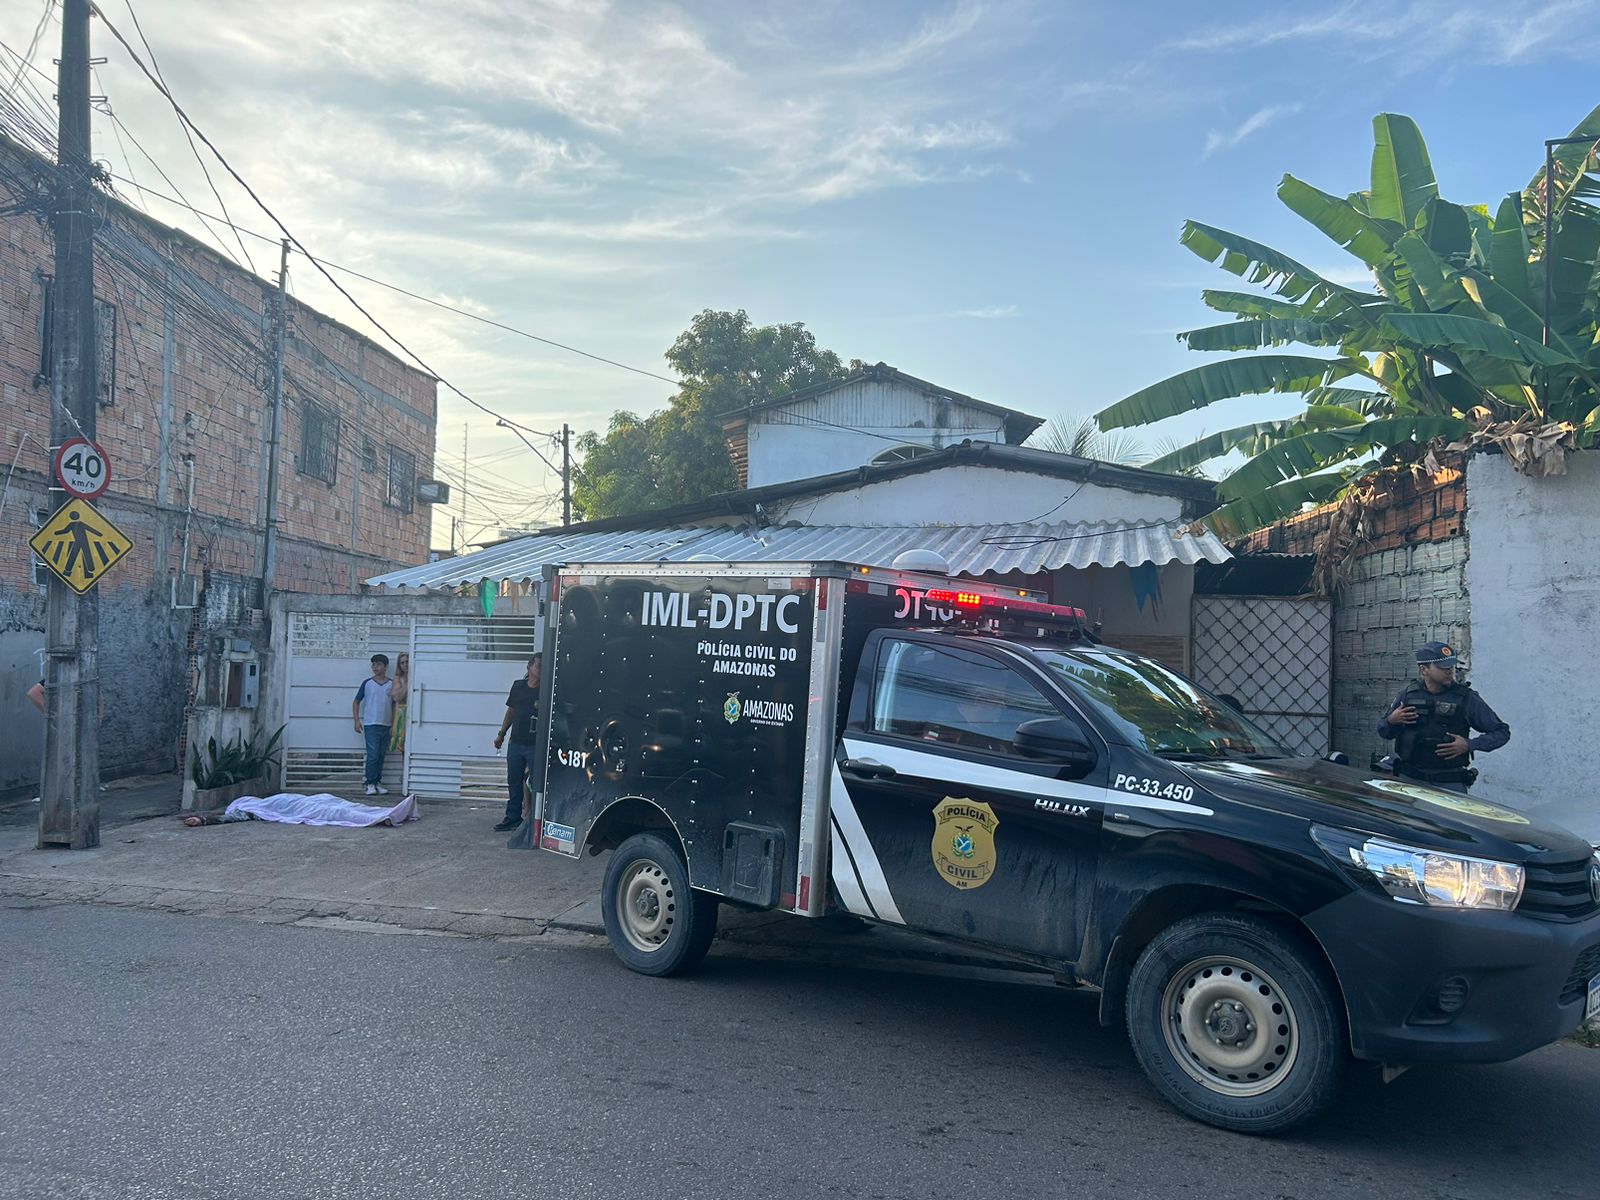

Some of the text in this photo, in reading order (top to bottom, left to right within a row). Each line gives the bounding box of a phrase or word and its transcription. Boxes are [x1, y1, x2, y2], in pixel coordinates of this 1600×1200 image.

[64, 452, 102, 479] 40
[71, 478, 96, 489] km/h
[641, 591, 800, 633] IML-DPTC
[697, 640, 797, 662] POLÍCIA CIVIL DO
[712, 660, 776, 678] AMAZONAS
[742, 699, 794, 722] AMAZONAS
[567, 750, 587, 769] 181
[1114, 773, 1194, 802] PC-33.450
[947, 806, 986, 822] POLÍCIA
[1034, 798, 1091, 818] HILUX
[947, 865, 978, 879] CIVIL
[956, 880, 968, 888] AM
